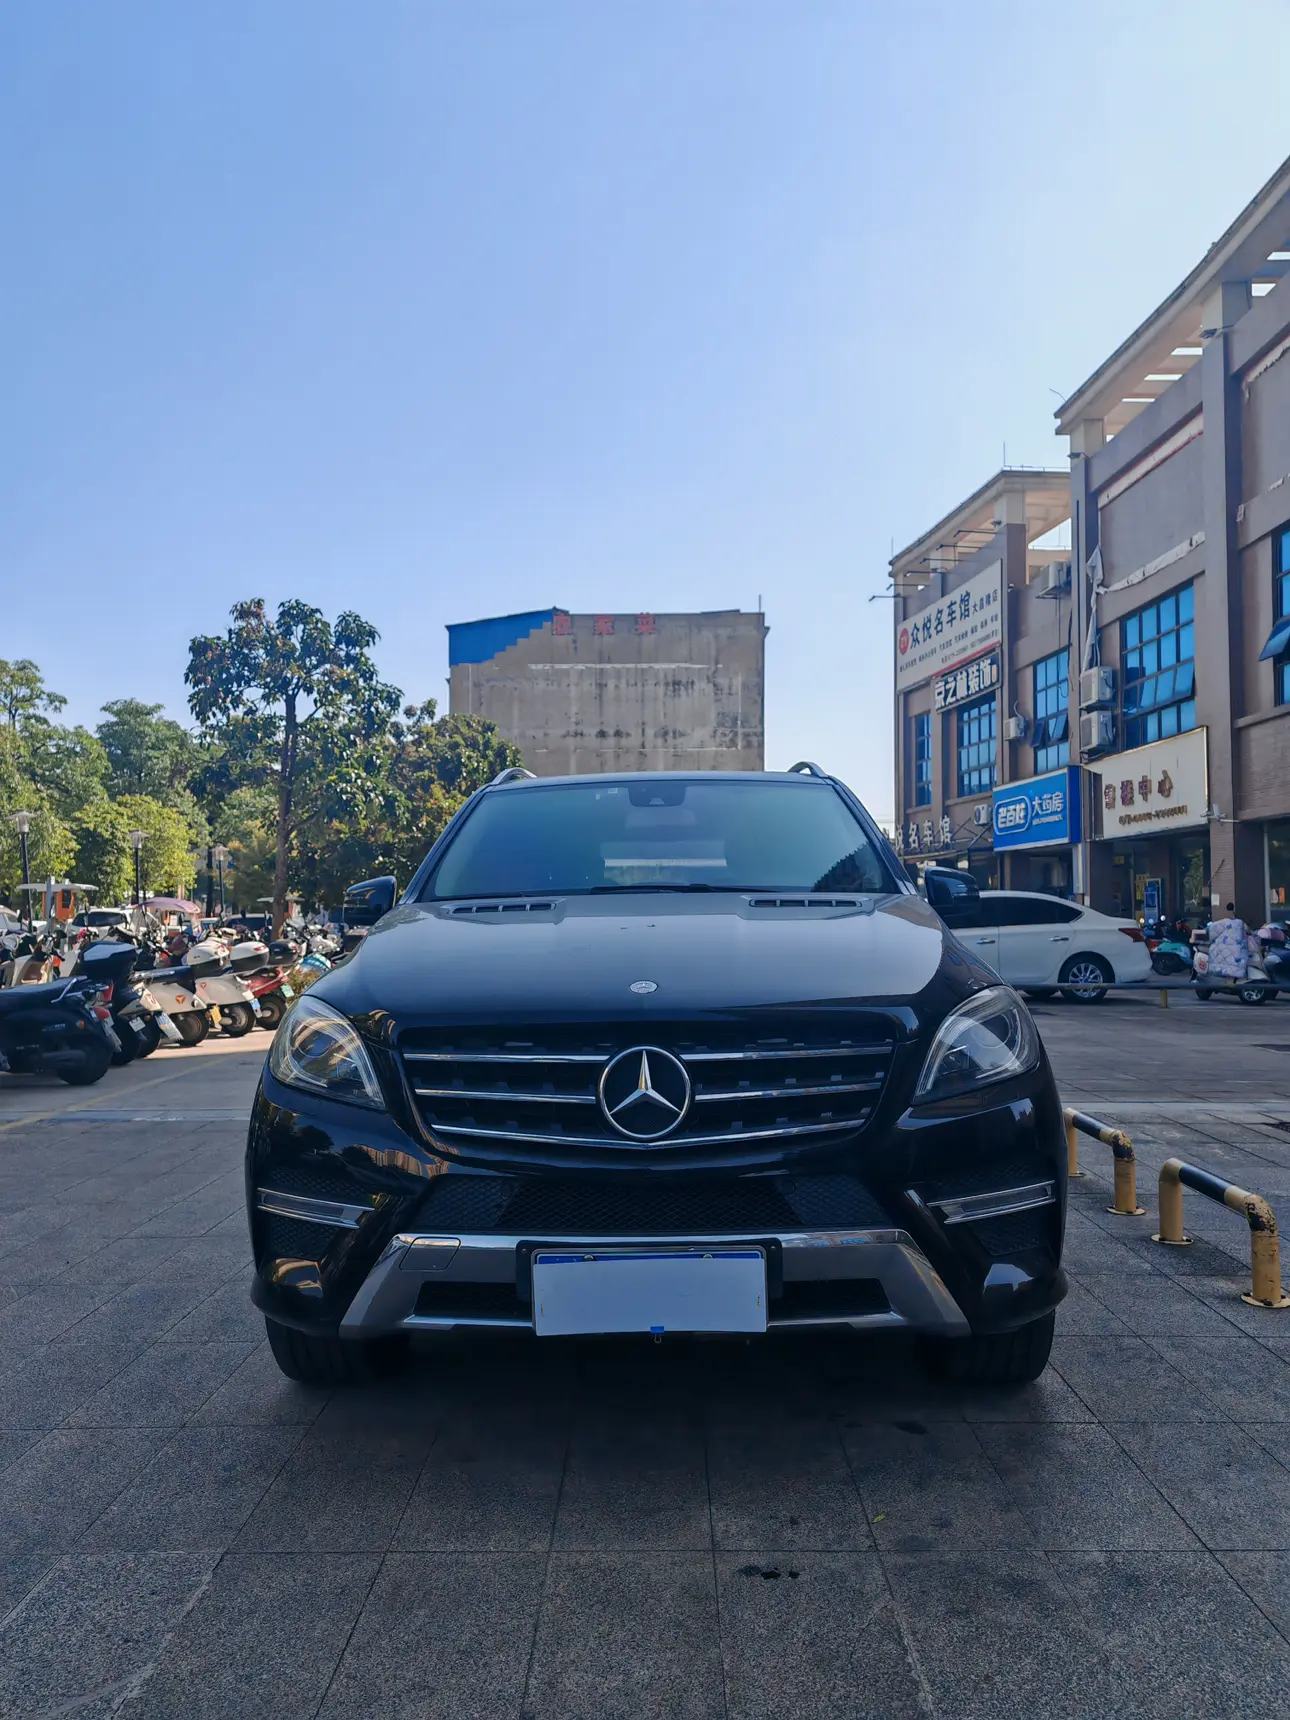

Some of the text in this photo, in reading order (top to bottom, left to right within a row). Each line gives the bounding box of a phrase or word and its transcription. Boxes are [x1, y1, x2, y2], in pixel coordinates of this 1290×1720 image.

[910, 591, 970, 650] 众悦名车馆
[998, 802, 1027, 829] 老百姓
[1032, 791, 1065, 816] 大药房
